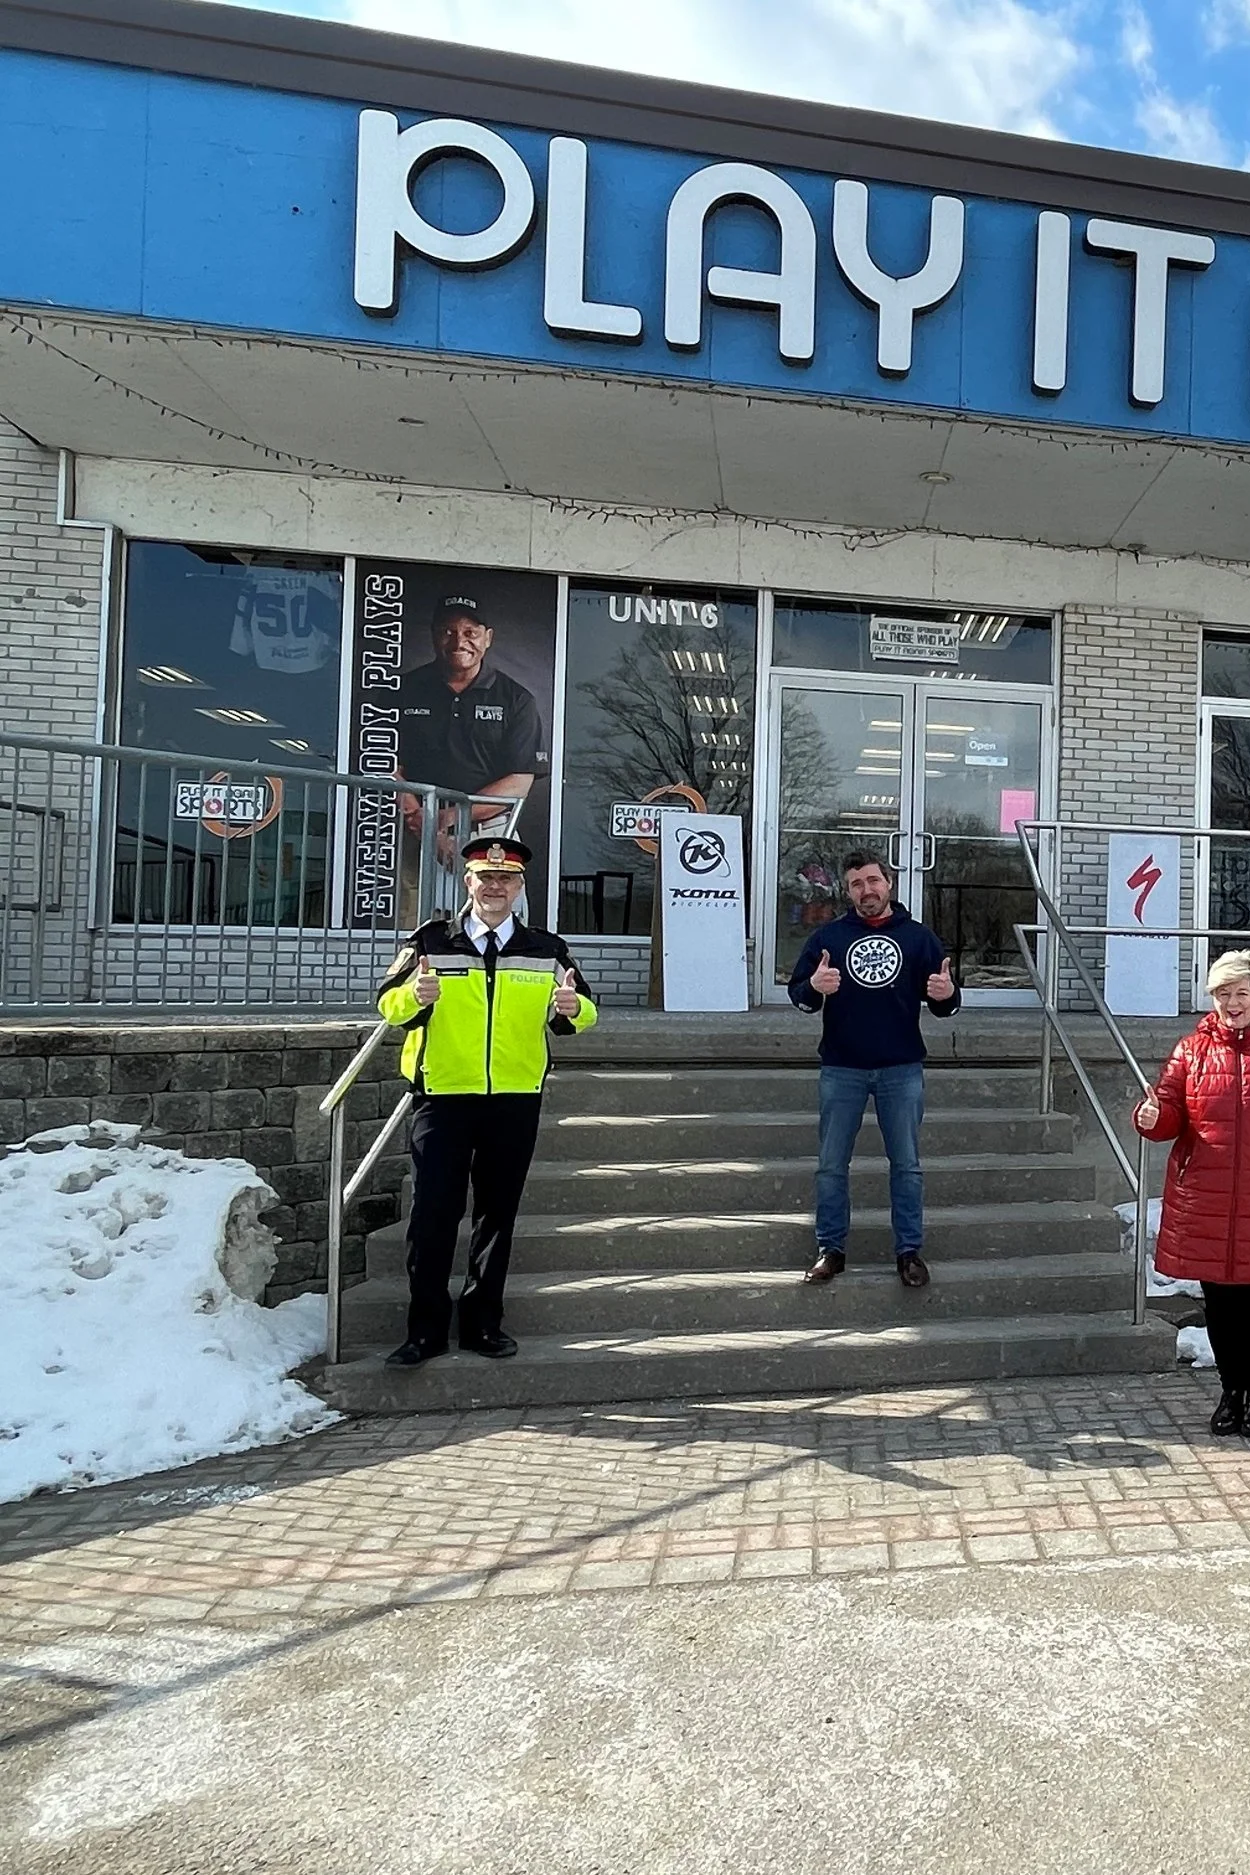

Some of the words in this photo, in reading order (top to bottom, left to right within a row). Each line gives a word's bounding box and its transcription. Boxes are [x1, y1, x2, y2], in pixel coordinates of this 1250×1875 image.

[353, 108, 964, 379] PLAY
[1031, 210, 1215, 409] IT
[445, 597, 477, 609] COACH
[609, 596, 689, 626] UNIT
[700, 603, 718, 629] 6
[362, 575, 403, 690] PLAYS
[872, 631, 886, 641] ALL
[889, 632, 914, 644] THOSE
[917, 634, 936, 645] WHO
[938, 635, 957, 647] PLAY
[969, 740, 997, 751] Open
[615, 807, 640, 817] PLAY
[643, 808, 653, 817] IT
[615, 817, 660, 834] SPO
[853, 941, 897, 960] HOCKEY
[509, 973, 546, 985] POLICE
[855, 964, 893, 981] NIGHT
